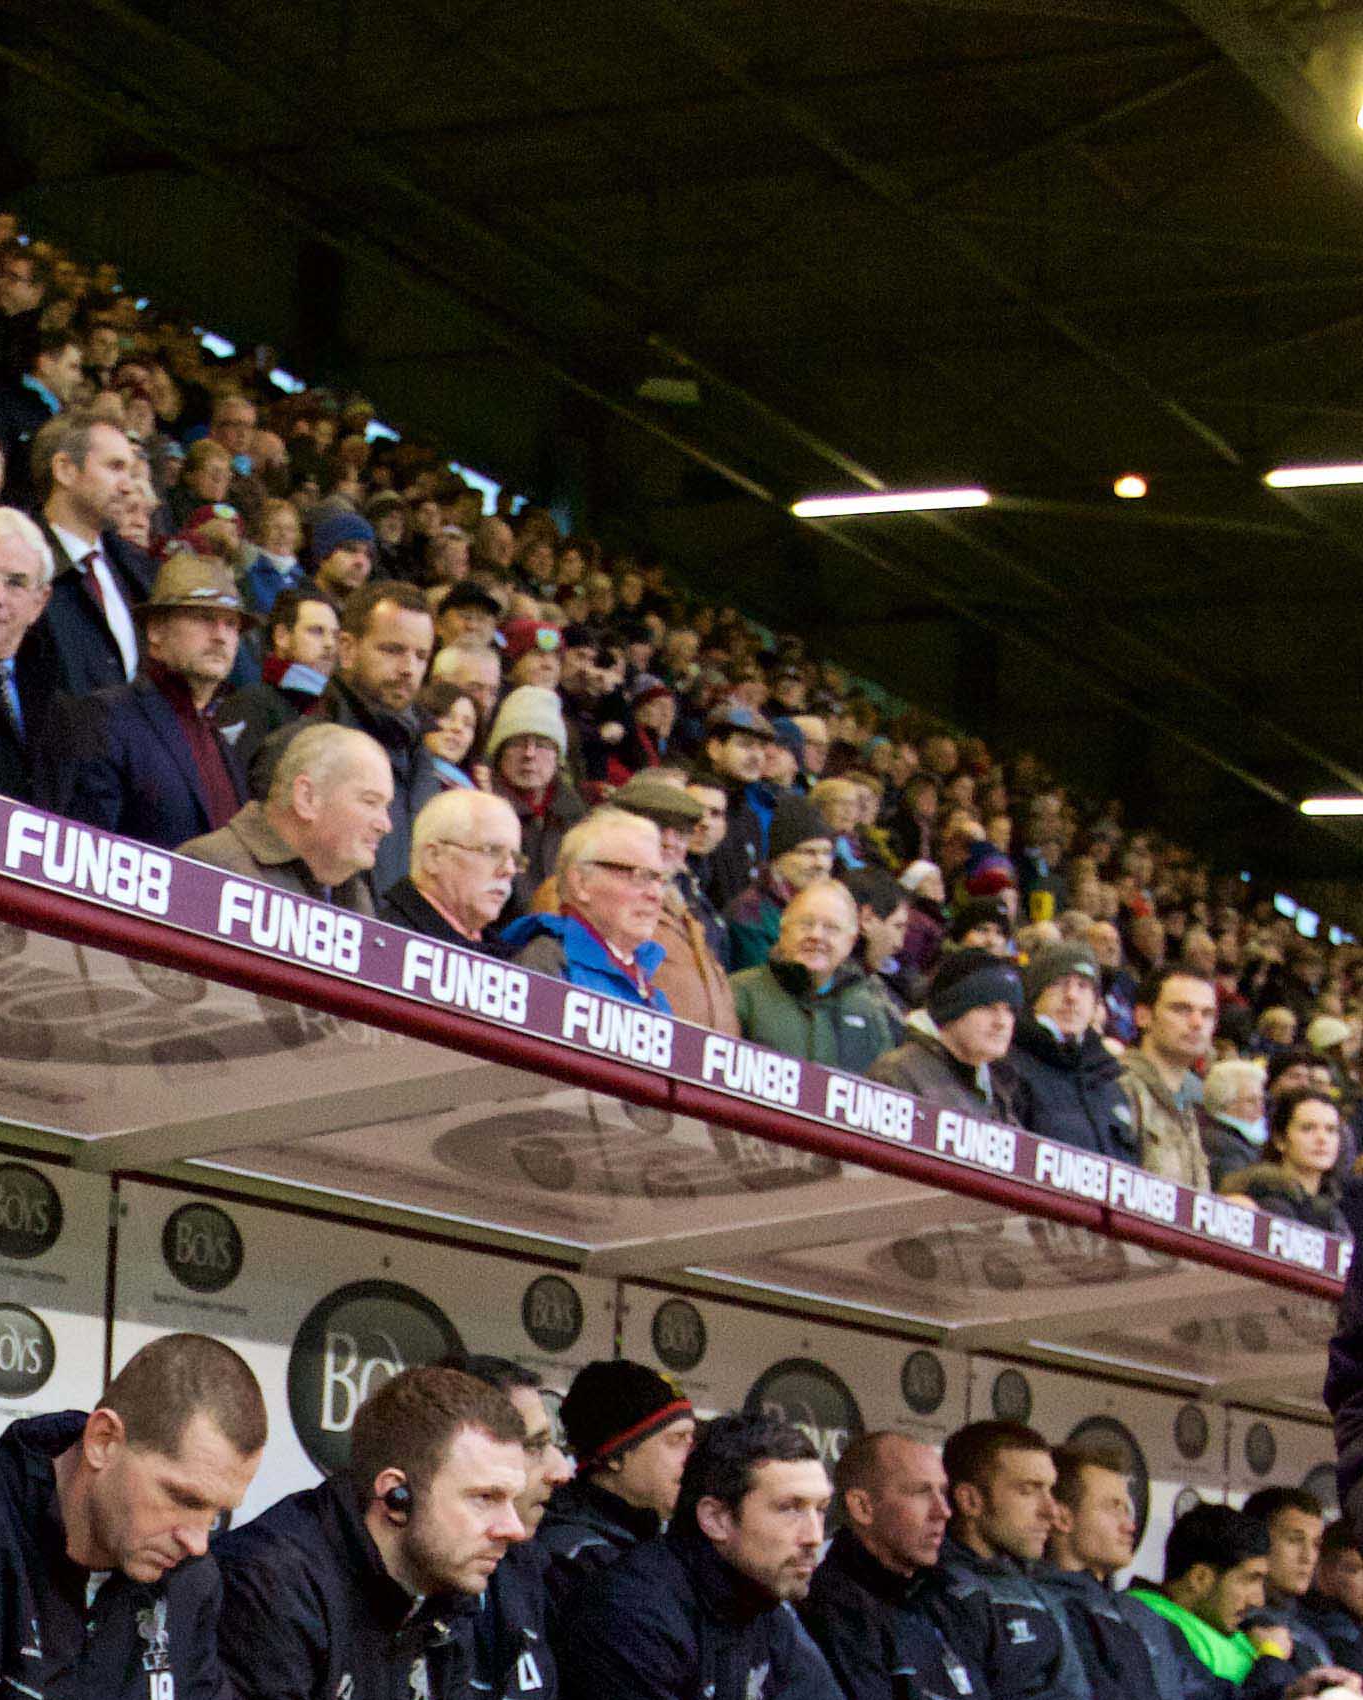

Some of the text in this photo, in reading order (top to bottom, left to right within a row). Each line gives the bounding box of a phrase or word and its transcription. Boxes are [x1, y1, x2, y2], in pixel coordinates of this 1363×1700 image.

[5, 810, 172, 916] FUN88
[218, 880, 363, 973] FUN88
[402, 939, 529, 1024] FUN88
[562, 990, 673, 1068] FUN88
[702, 1035, 801, 1107] FUN88
[825, 1075, 914, 1142] FUN88
[936, 1110, 1016, 1173] FUN88
[1037, 1143, 1108, 1201] FUN88
